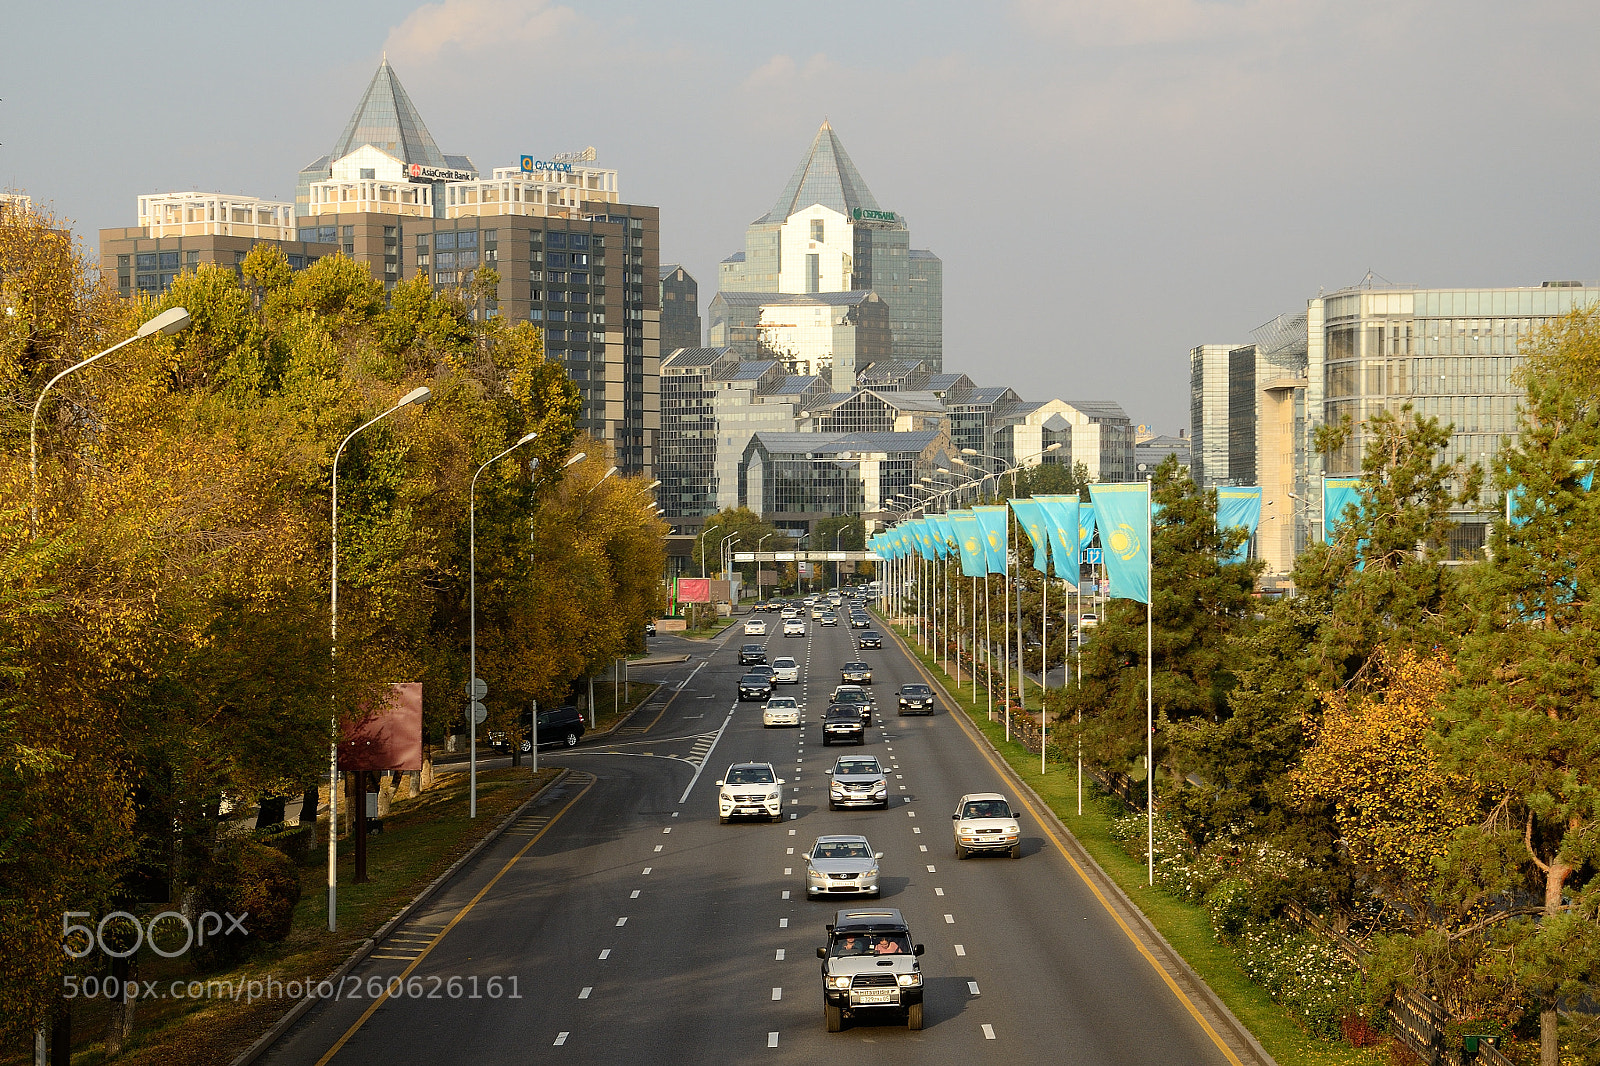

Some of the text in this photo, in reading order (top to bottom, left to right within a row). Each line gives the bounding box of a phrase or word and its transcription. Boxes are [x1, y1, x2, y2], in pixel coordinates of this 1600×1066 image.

[535, 160, 572, 173] QAZKOM
[421, 168, 470, 180] AsiaCredit Bank
[862, 209, 895, 220] СБЕРБАНК
